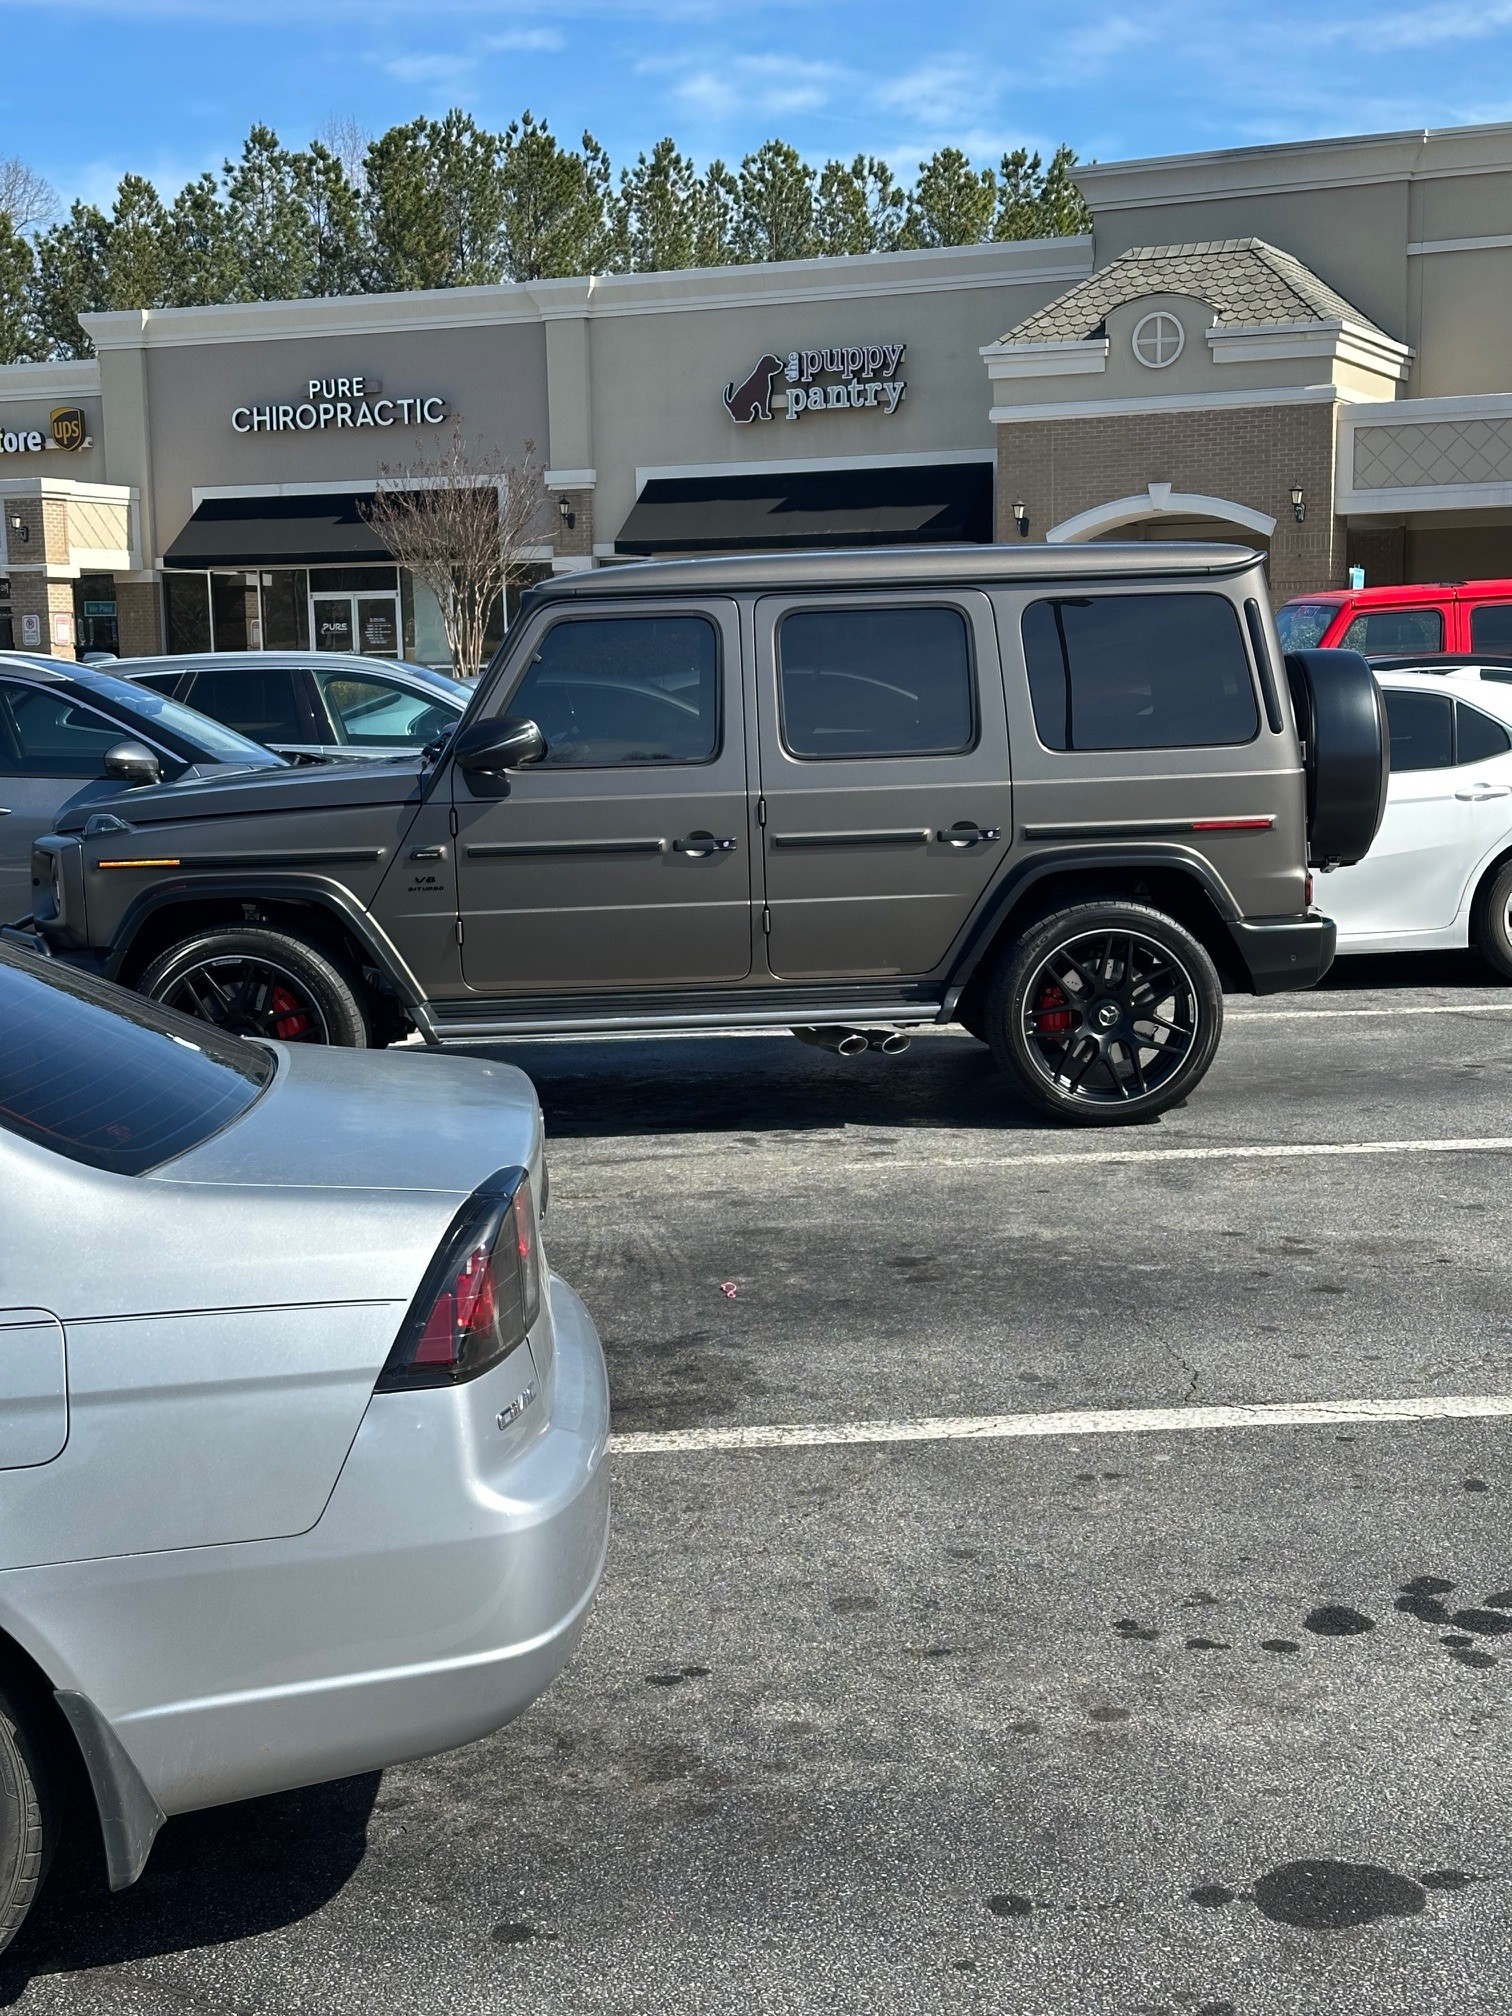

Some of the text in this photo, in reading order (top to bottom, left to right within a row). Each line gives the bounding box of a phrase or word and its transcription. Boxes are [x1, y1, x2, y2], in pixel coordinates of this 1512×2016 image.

[784, 344, 904, 382] the puppy
[308, 376, 366, 400] PURE
[785, 377, 905, 420] pantry
[231, 397, 445, 433] CHIROPRACTIC
[53, 420, 80, 445] ups
[321, 622, 348, 633] PURE
[415, 876, 436, 884] V8
